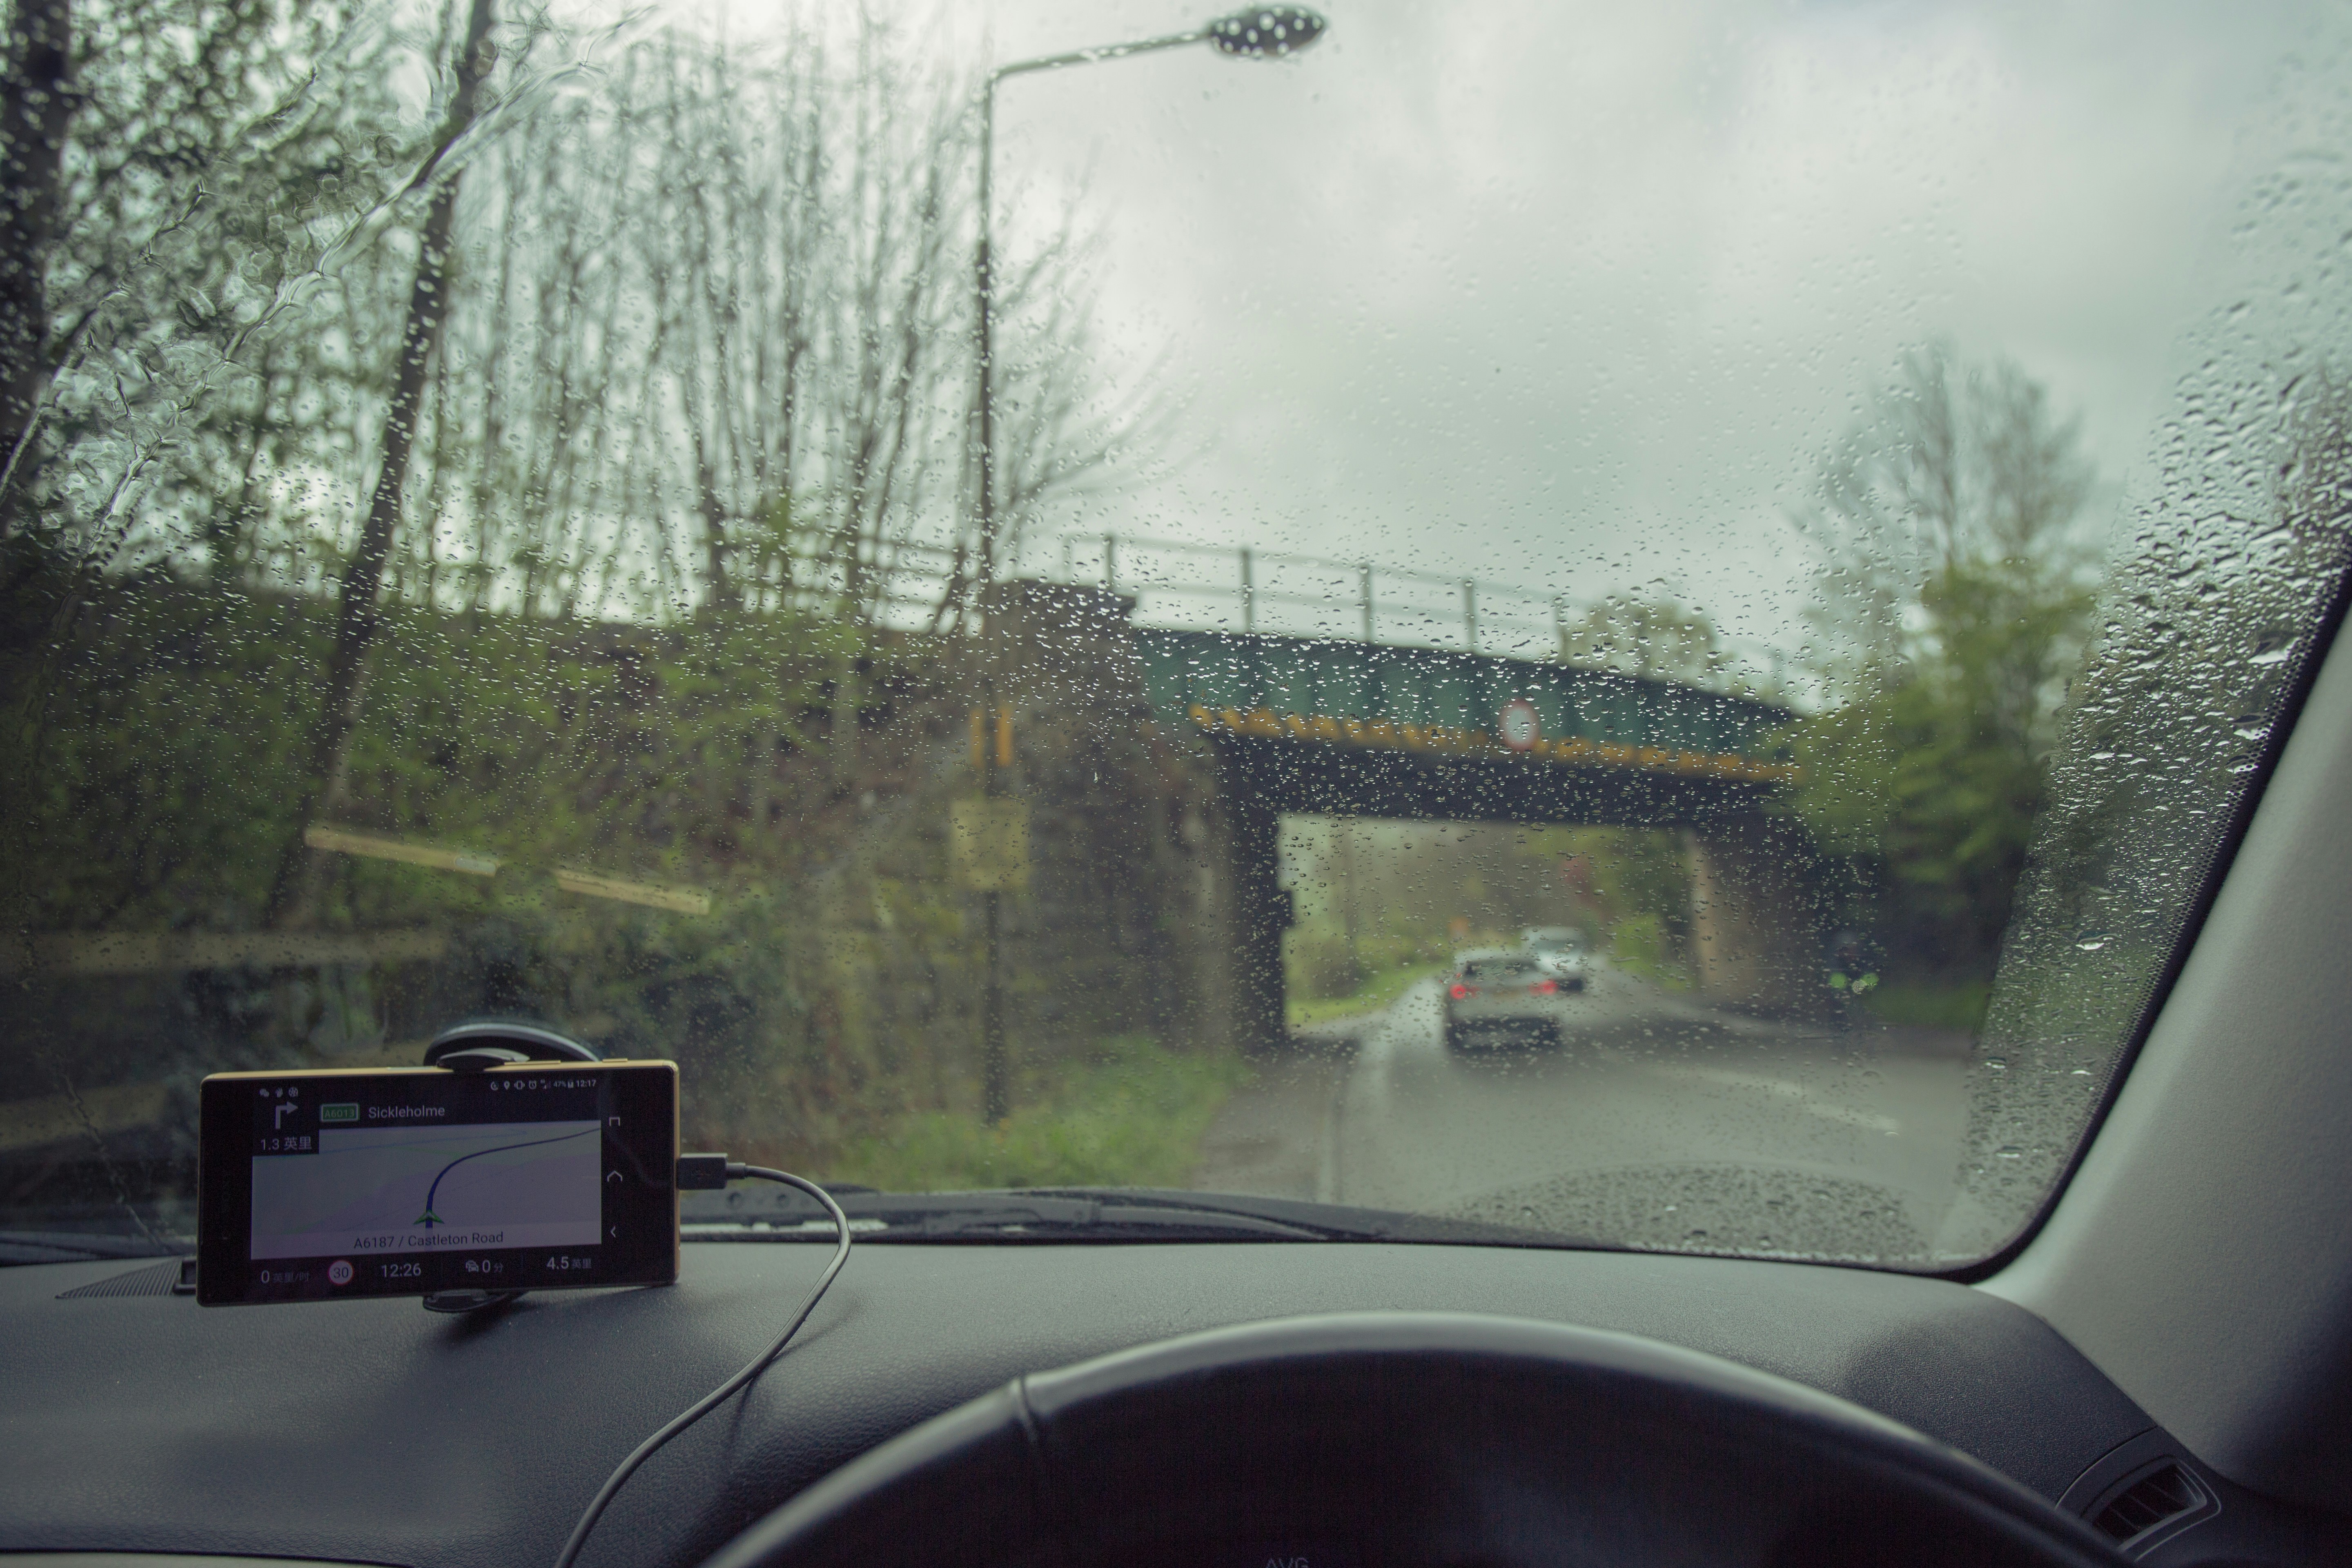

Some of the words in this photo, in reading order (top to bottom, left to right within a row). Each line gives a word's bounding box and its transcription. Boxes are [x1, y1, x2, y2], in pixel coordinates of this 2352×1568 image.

[325, 1109, 354, 1118] A6013
[368, 1105, 445, 1118] Sickleholme
[261, 1138, 279, 1151] 1.3
[284, 1136, 312, 1150] 英里
[354, 1236, 394, 1249] A6187
[409, 1233, 468, 1247] Castleton
[472, 1231, 503, 1243] Road
[381, 1263, 421, 1277] 12:26
[482, 1259, 490, 1273] 0
[546, 1256, 569, 1270] 4.5
[261, 1270, 270, 1283] 0
[333, 1267, 349, 1278] 30
